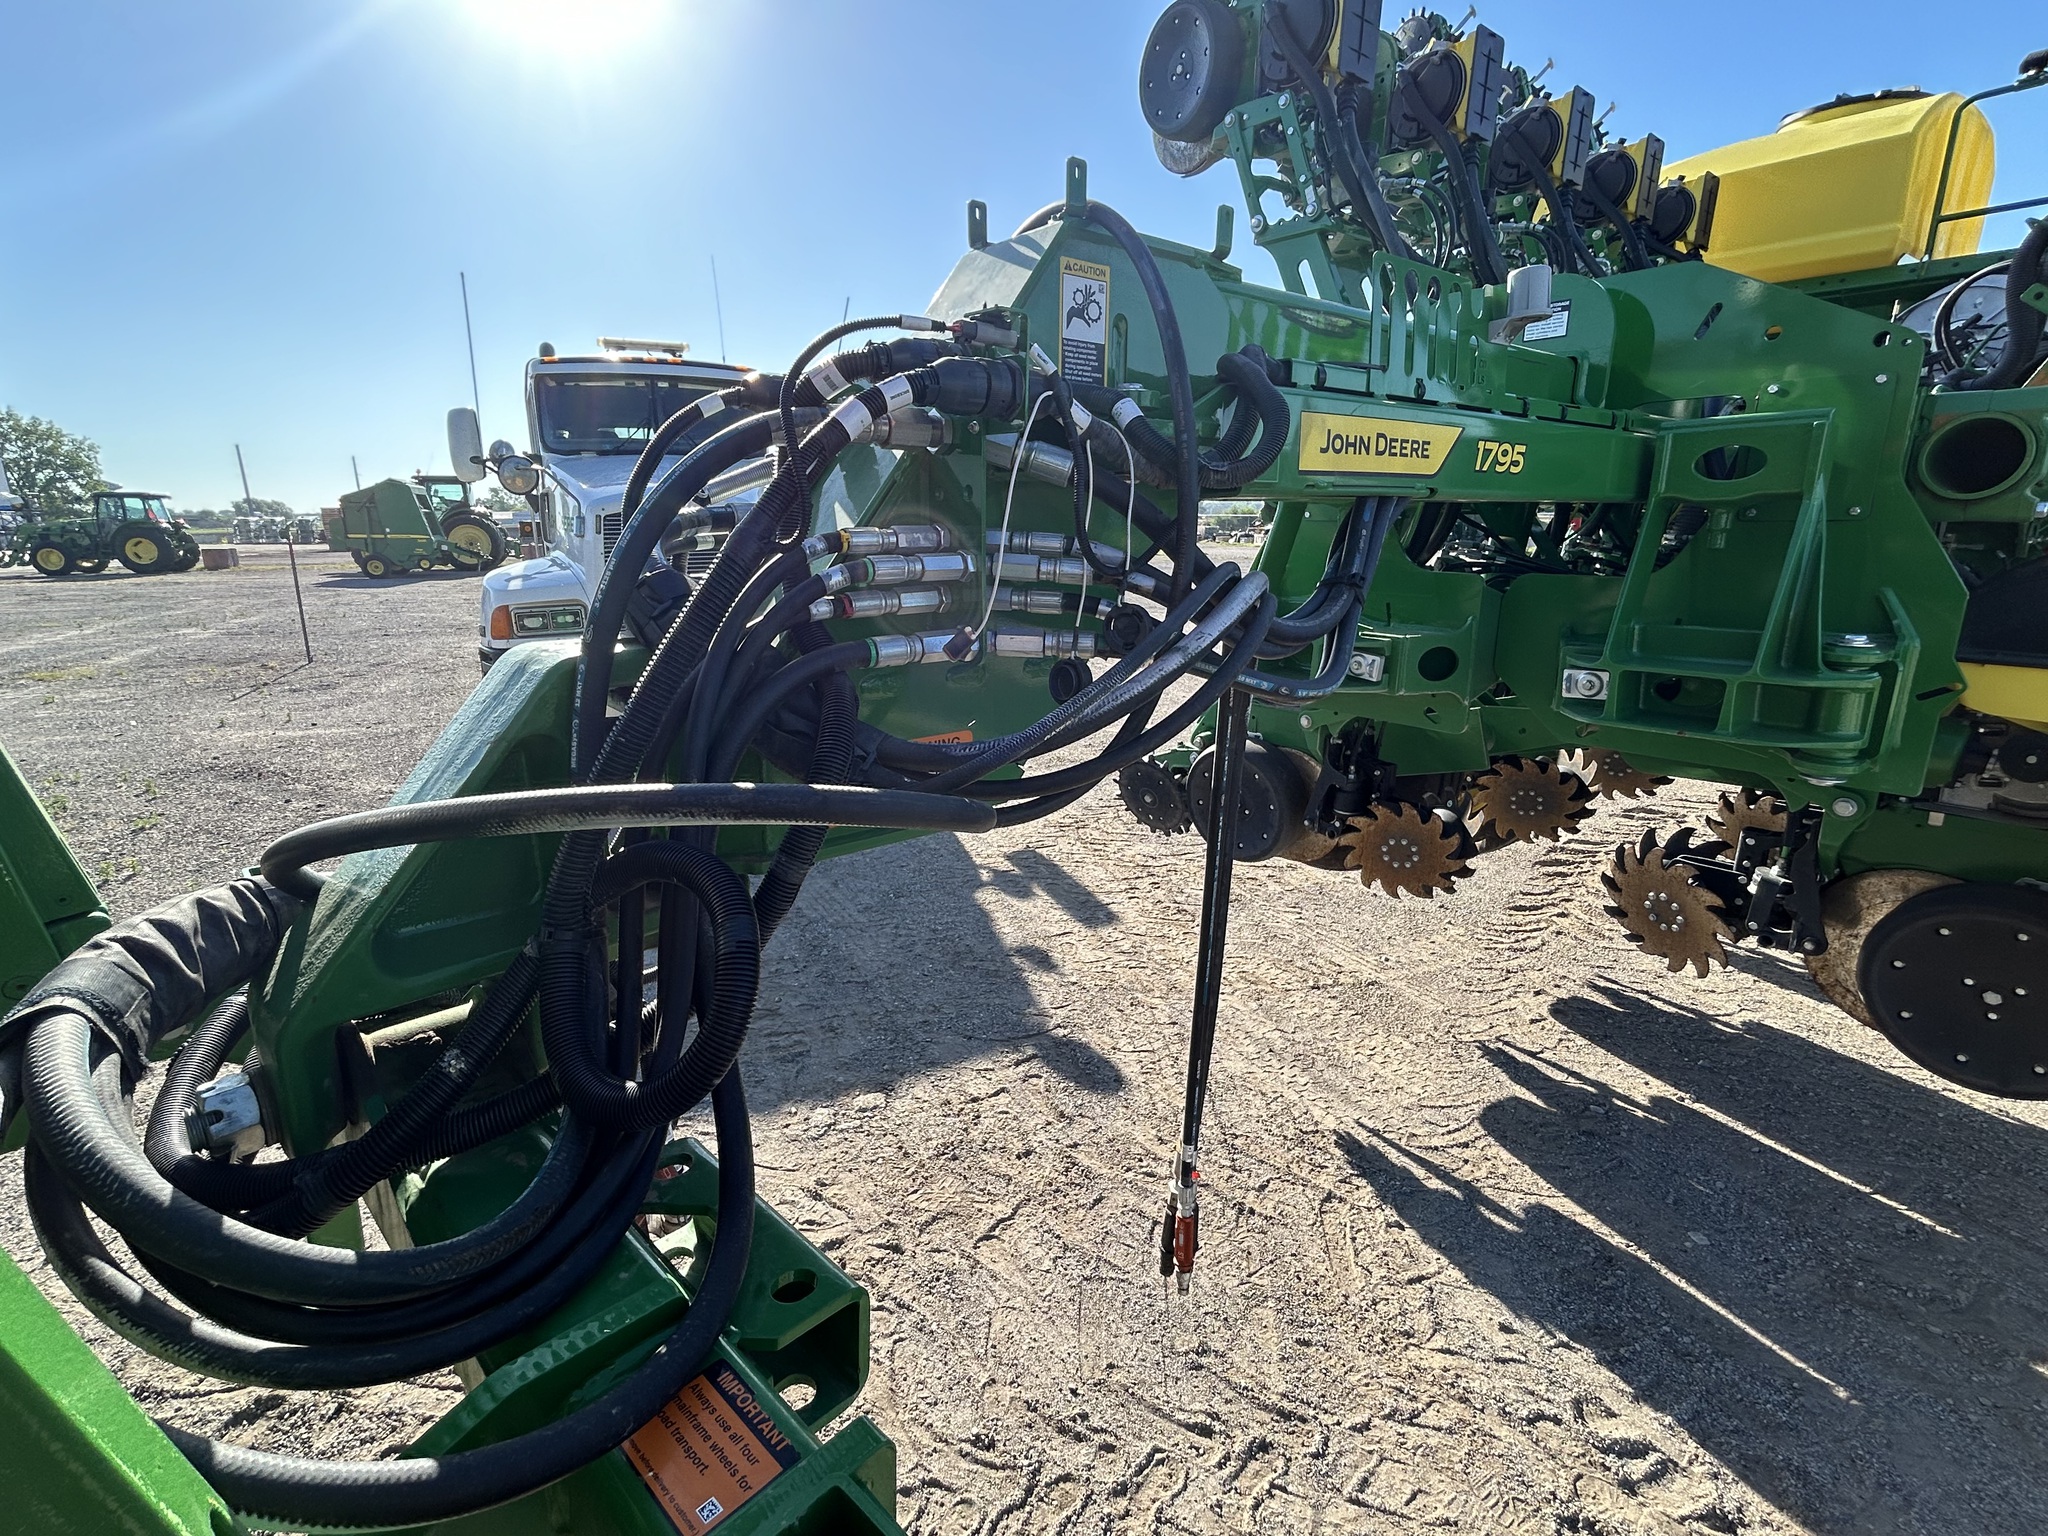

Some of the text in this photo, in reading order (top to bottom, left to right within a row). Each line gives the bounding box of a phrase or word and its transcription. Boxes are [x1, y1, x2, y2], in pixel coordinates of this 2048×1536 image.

[1073, 262, 1106, 278] CAUTION
[1320, 429, 1431, 459] JOHN DEERE
[1474, 440, 1527, 474] 1795
[689, 1382, 760, 1467] Always use all four
[717, 1370, 792, 1451] IMPORTANT
[656, 1410, 711, 1477] oad transport.
[672, 1395, 754, 1494] mainframe wheels for
[639, 1452, 655, 1473] before
[652, 1471, 670, 1497] delivery
[668, 1494, 676, 1504] to
